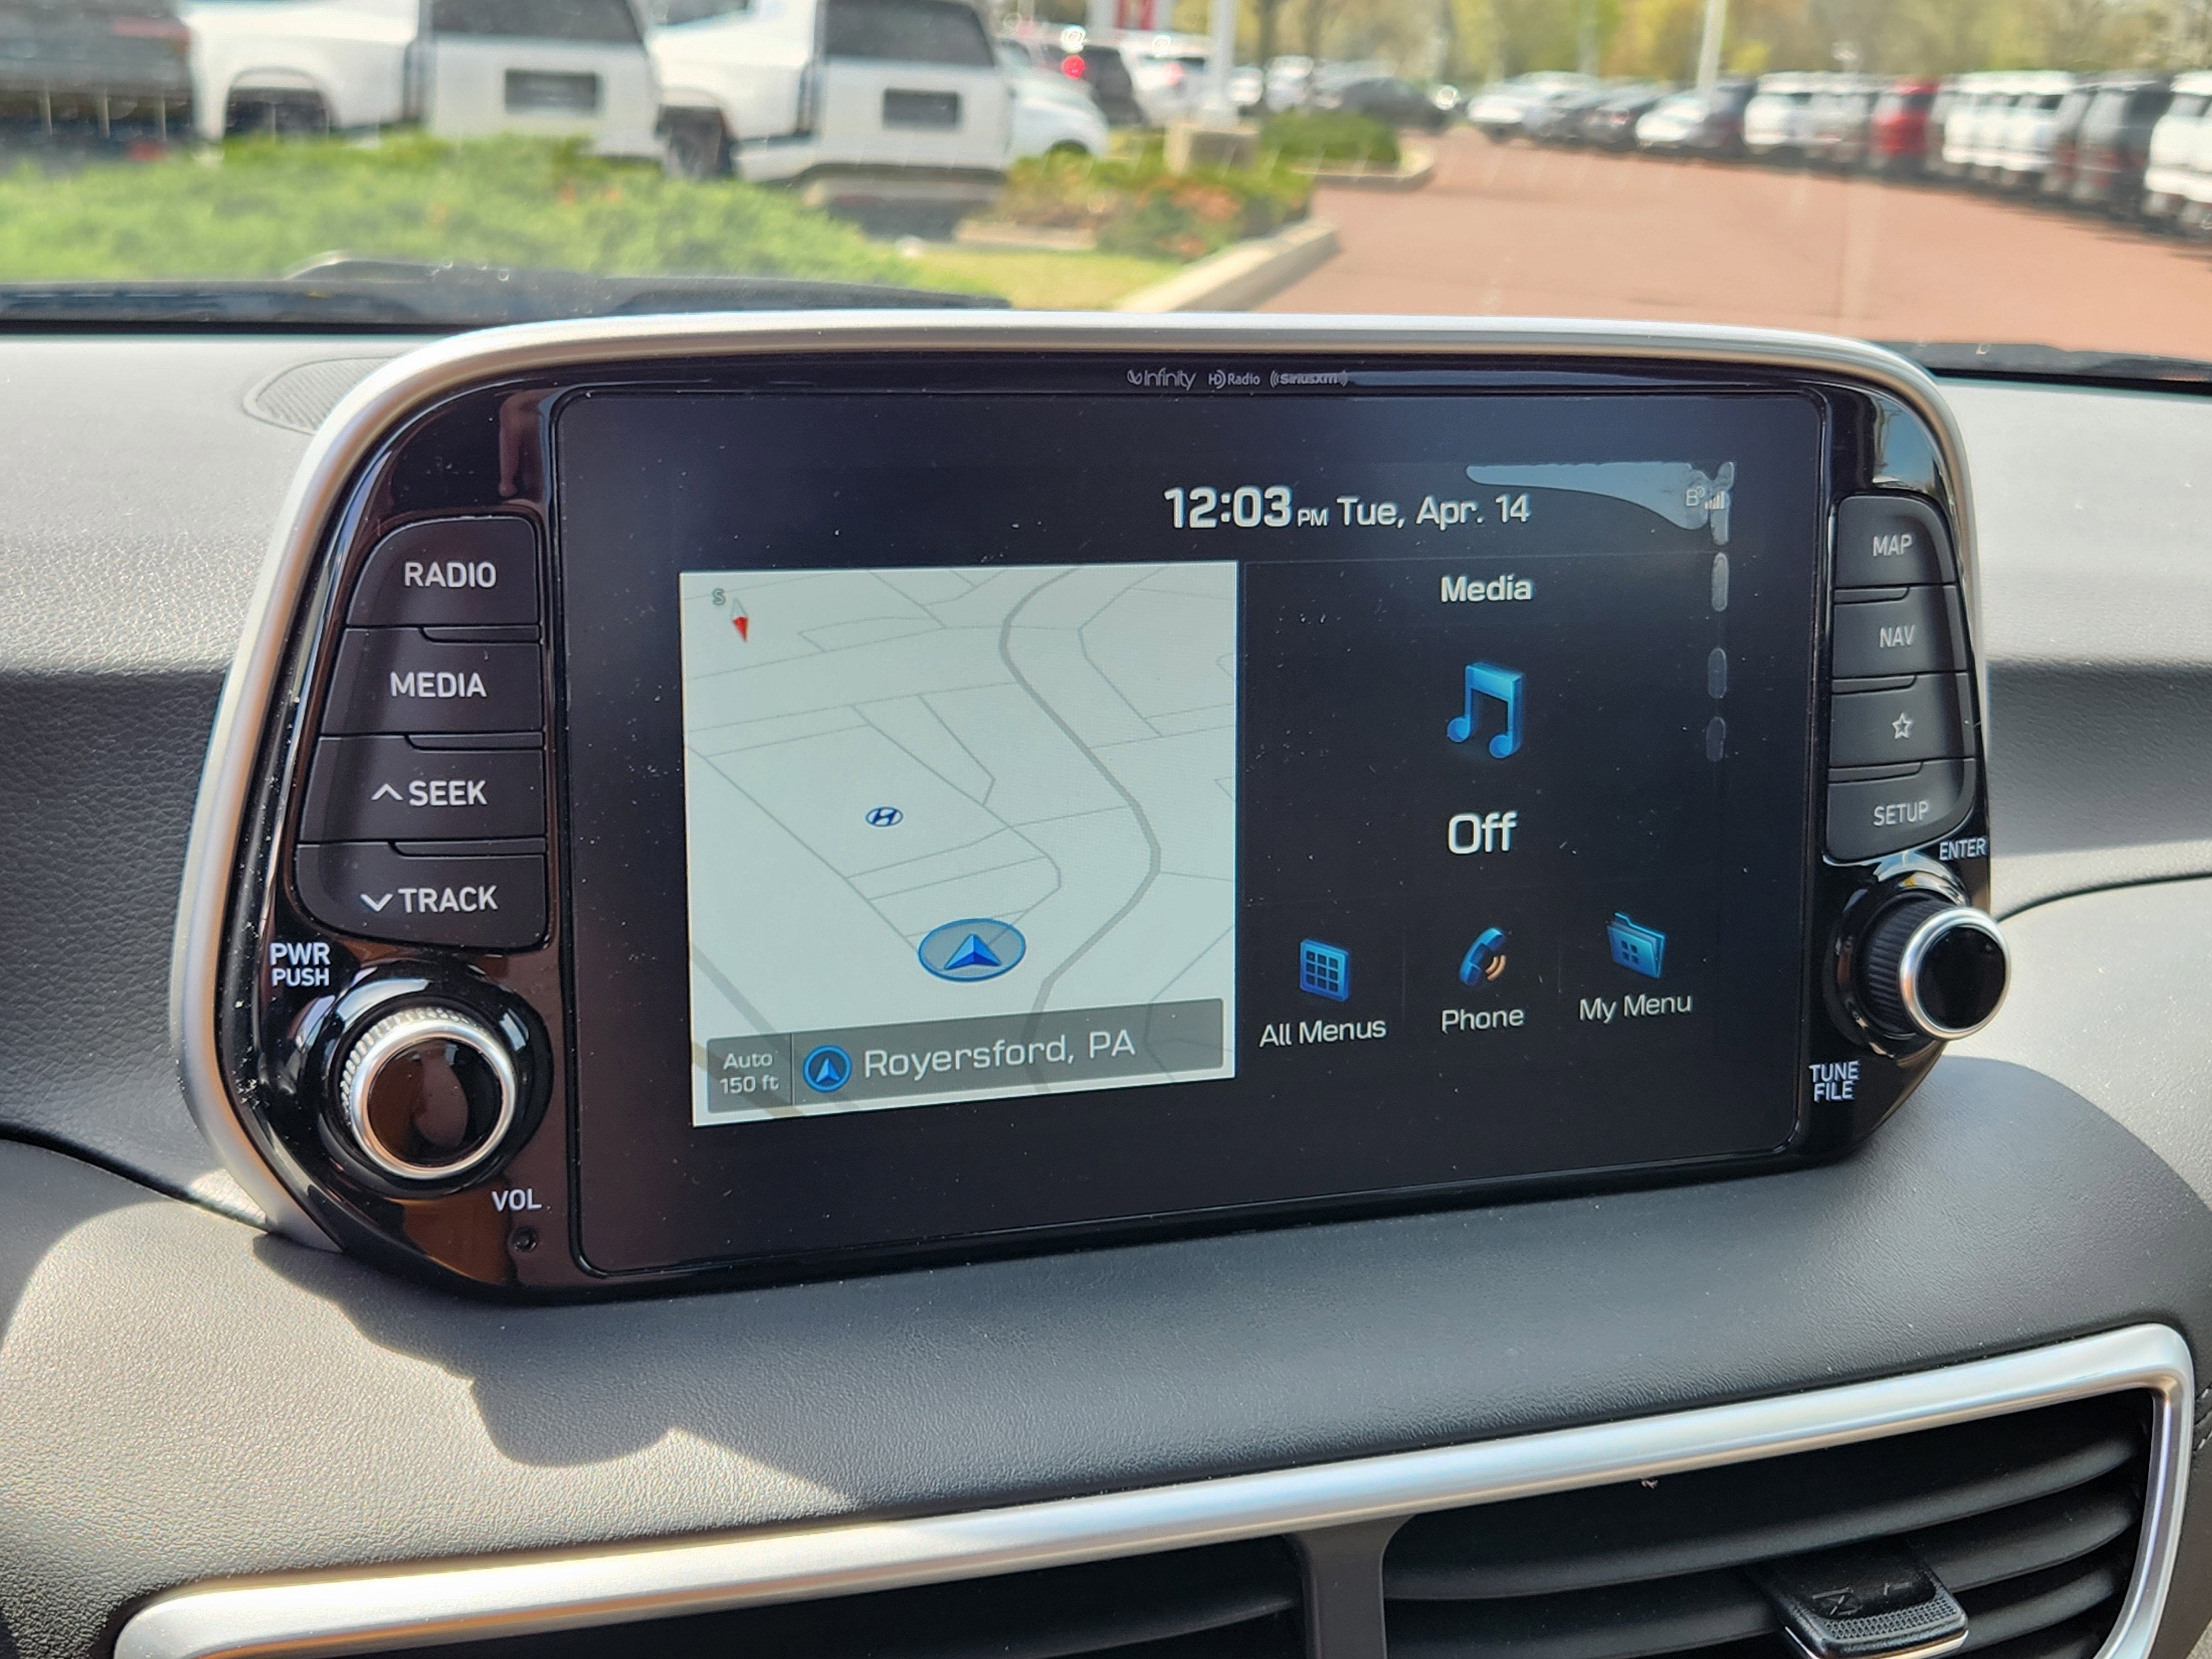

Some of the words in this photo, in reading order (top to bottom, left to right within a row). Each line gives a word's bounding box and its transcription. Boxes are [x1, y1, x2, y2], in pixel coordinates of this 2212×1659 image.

[1228, 371, 1261, 385] Radio
[1164, 486, 1293, 529] 12:03
[1297, 508, 1328, 526] PM
[1336, 497, 1405, 529] Tue,
[1416, 497, 1484, 530] Apr.
[1496, 494, 1530, 523] 14
[1872, 534, 1913, 557] MAP
[404, 561, 497, 588] RADIO
[1441, 574, 1533, 603] Media
[1880, 624, 1916, 648] NAV
[390, 671, 487, 698] MEDIA
[408, 779, 488, 807] SEEK
[1873, 800, 1929, 827] SETUP
[1447, 810, 1519, 855] Off
[1939, 837, 1987, 861] ENTER
[398, 885, 499, 914] TRACK
[269, 942, 331, 966] PWR
[270, 967, 330, 988] PUSH
[1441, 1007, 1525, 1034] Phone
[1578, 998, 1618, 1024] My
[1624, 994, 1693, 1018] Menu
[1258, 1024, 1293, 1048] All
[1299, 1018, 1387, 1044] Menus
[723, 1050, 774, 1071] Auto
[863, 1035, 1076, 1083] Royersford,
[1088, 1029, 1136, 1059] PA
[719, 1075, 758, 1095] 150
[761, 1073, 780, 1093] ft
[1808, 1060, 1860, 1083] TUNE
[1814, 1080, 1855, 1103] FILE
[491, 1188, 542, 1212] VOL
